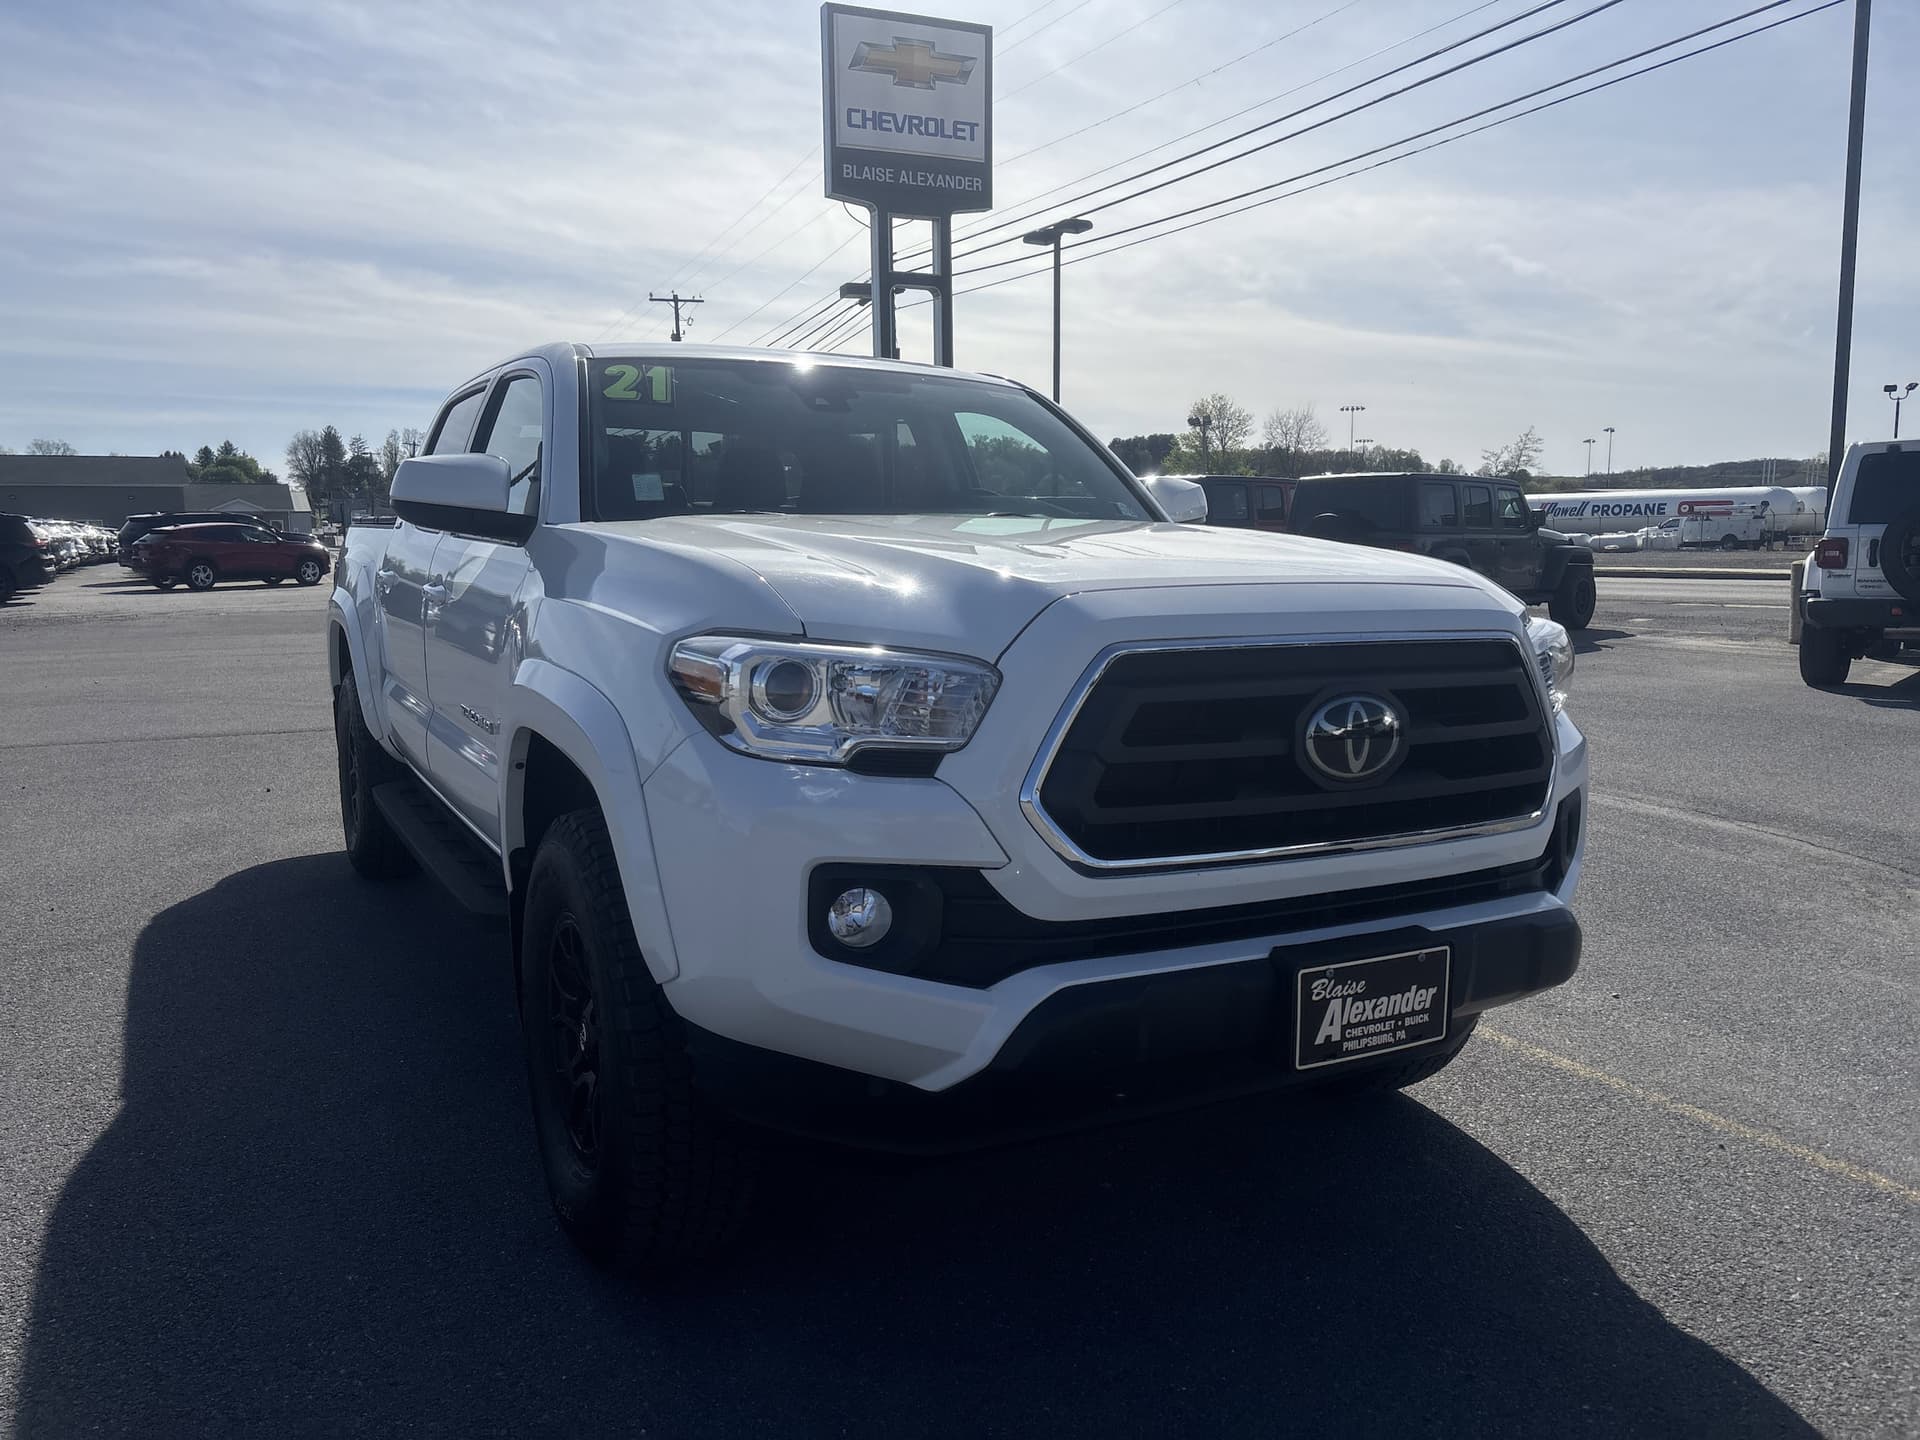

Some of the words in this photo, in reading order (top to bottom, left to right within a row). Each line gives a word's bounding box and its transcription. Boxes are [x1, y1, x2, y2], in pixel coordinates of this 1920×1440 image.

[846, 107, 980, 142] CHEVROLET
[842, 163, 895, 183] BLAISE
[899, 170, 983, 192] ALEXANDER
[602, 364, 672, 404] 21
[1591, 502, 1668, 517] PROPANE
[1311, 978, 1367, 1001] Blaise
[1314, 984, 1438, 1046] Alexander
[1345, 1020, 1396, 1039] CHEVROLET
[1404, 1012, 1430, 1027] BUICK
[1342, 1032, 1395, 1052] PHILIPSBURG,
[1395, 1029, 1407, 1041] PA
